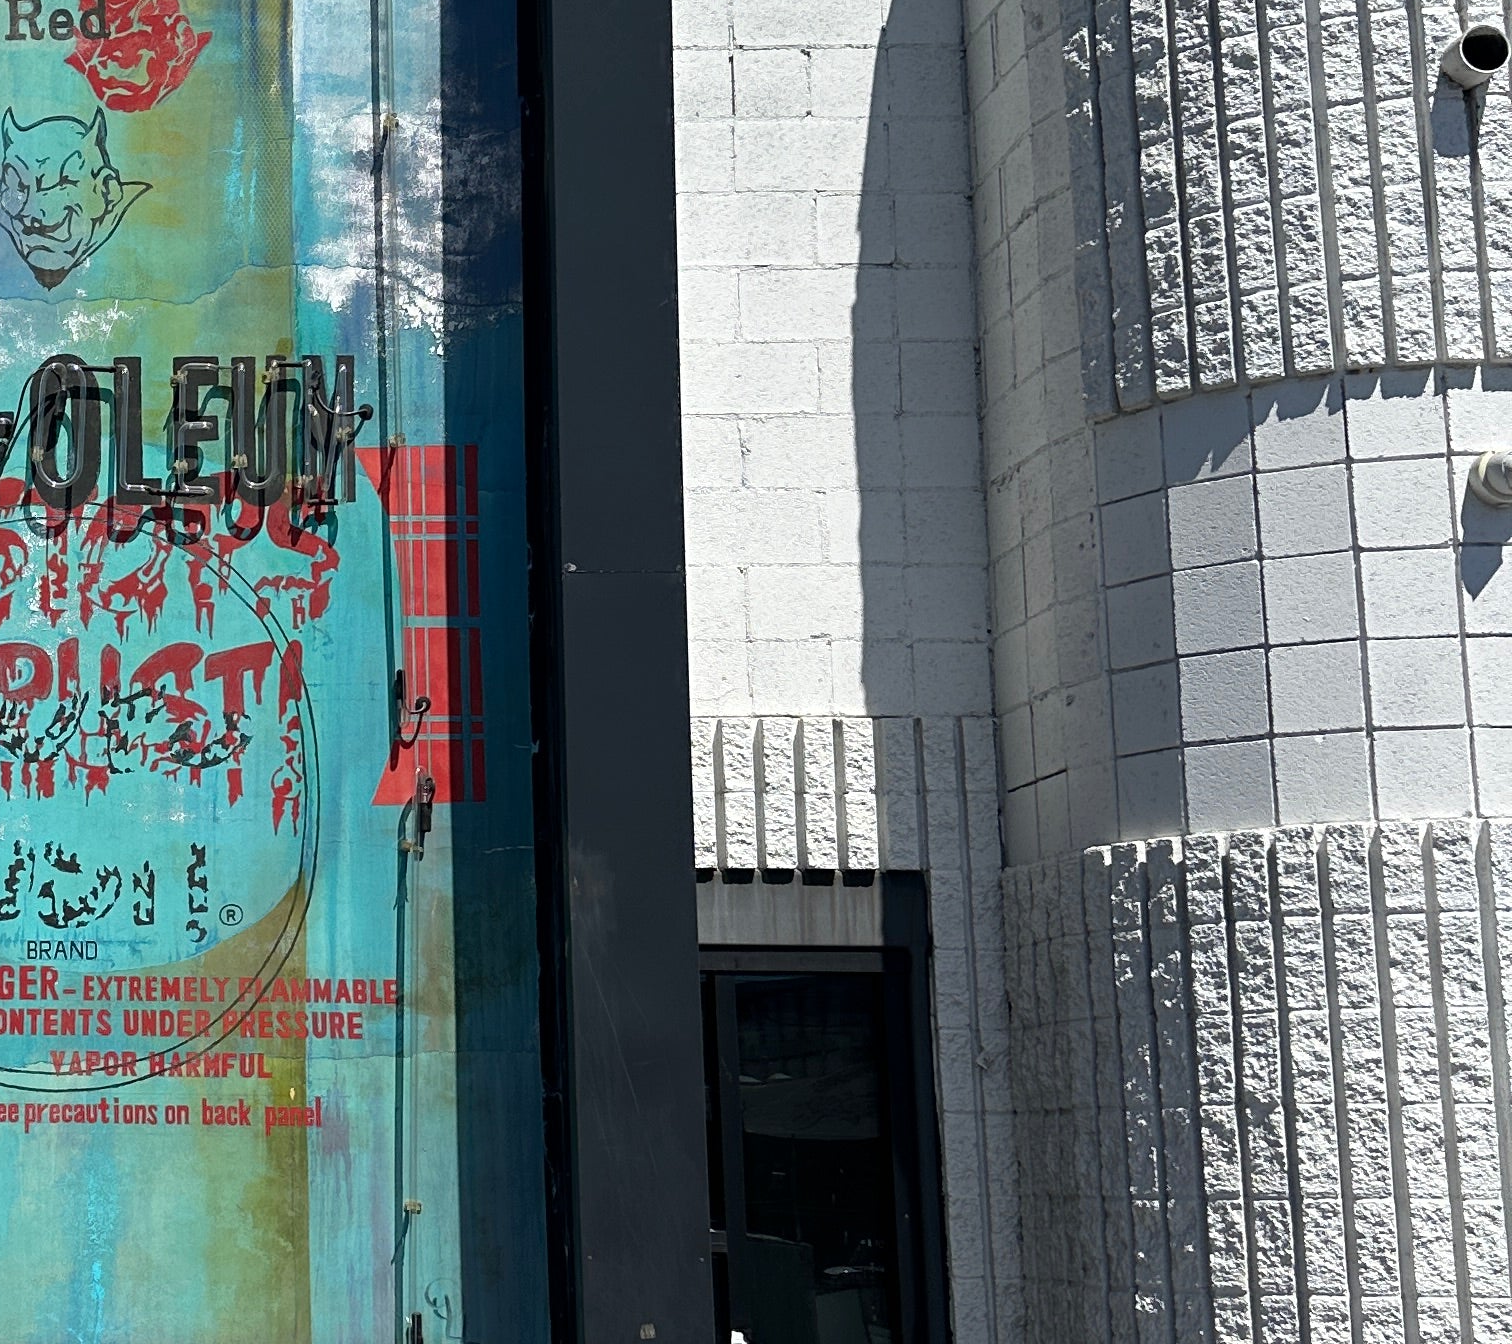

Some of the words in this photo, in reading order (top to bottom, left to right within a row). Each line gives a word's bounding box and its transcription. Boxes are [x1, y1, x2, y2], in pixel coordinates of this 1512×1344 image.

[26, 939, 98, 961] BRAND
[238, 976, 399, 1005] FLAMMABLE
[122, 1008, 211, 1038] UNDER
[222, 1009, 364, 1040] PRESSURE
[49, 1050, 137, 1077] VAPOR
[148, 1051, 273, 1079] HARMFUL
[23, 1096, 159, 1134] precautions
[164, 1104, 190, 1126] on
[201, 1097, 252, 1126] back
[264, 1095, 323, 1137] panel
